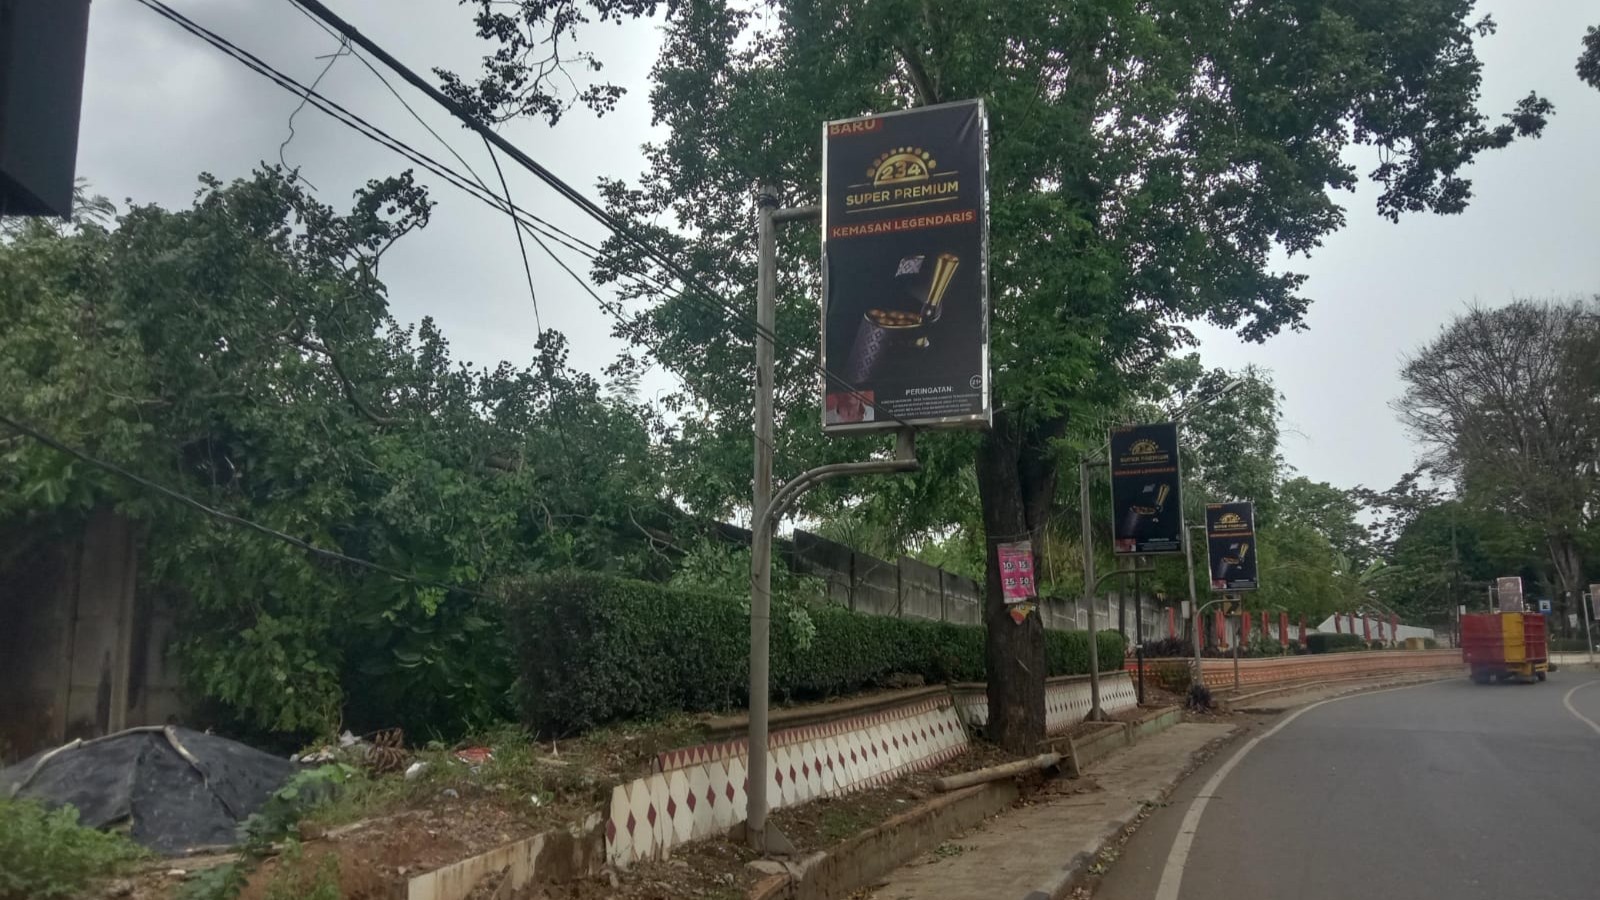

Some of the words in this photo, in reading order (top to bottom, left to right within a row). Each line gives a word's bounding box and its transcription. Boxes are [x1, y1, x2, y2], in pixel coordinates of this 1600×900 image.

[830, 120, 876, 135] BARU
[881, 160, 922, 181] 234
[846, 190, 890, 206] SUPER
[894, 181, 959, 199] PREMIUM
[833, 221, 892, 238] KEMASAN
[894, 211, 974, 230] LEGENDARIS
